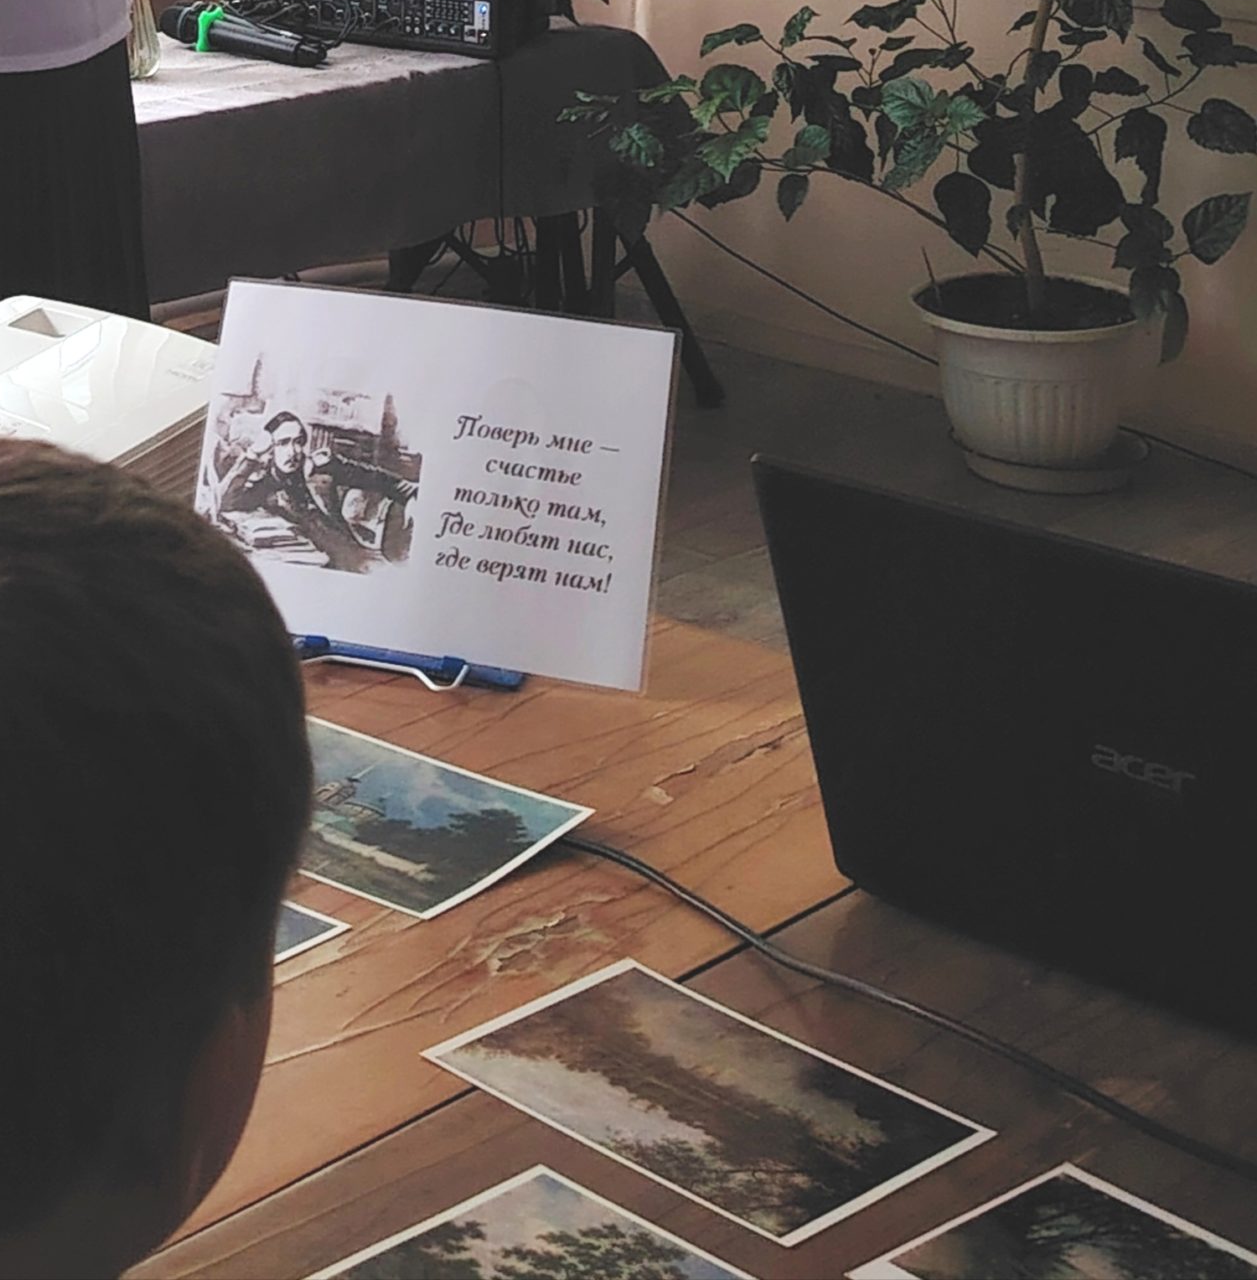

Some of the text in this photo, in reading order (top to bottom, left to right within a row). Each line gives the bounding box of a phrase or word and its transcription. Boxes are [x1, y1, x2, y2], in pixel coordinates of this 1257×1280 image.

[453, 414, 540, 449] Поверь
[545, 434, 593, 455] мне
[485, 457, 583, 486] счастье
[453, 486, 608, 528] только там,
[434, 510, 615, 563] Где любят нас,
[434, 546, 613, 594] где верят нам!
[1091, 743, 1197, 793] acer
